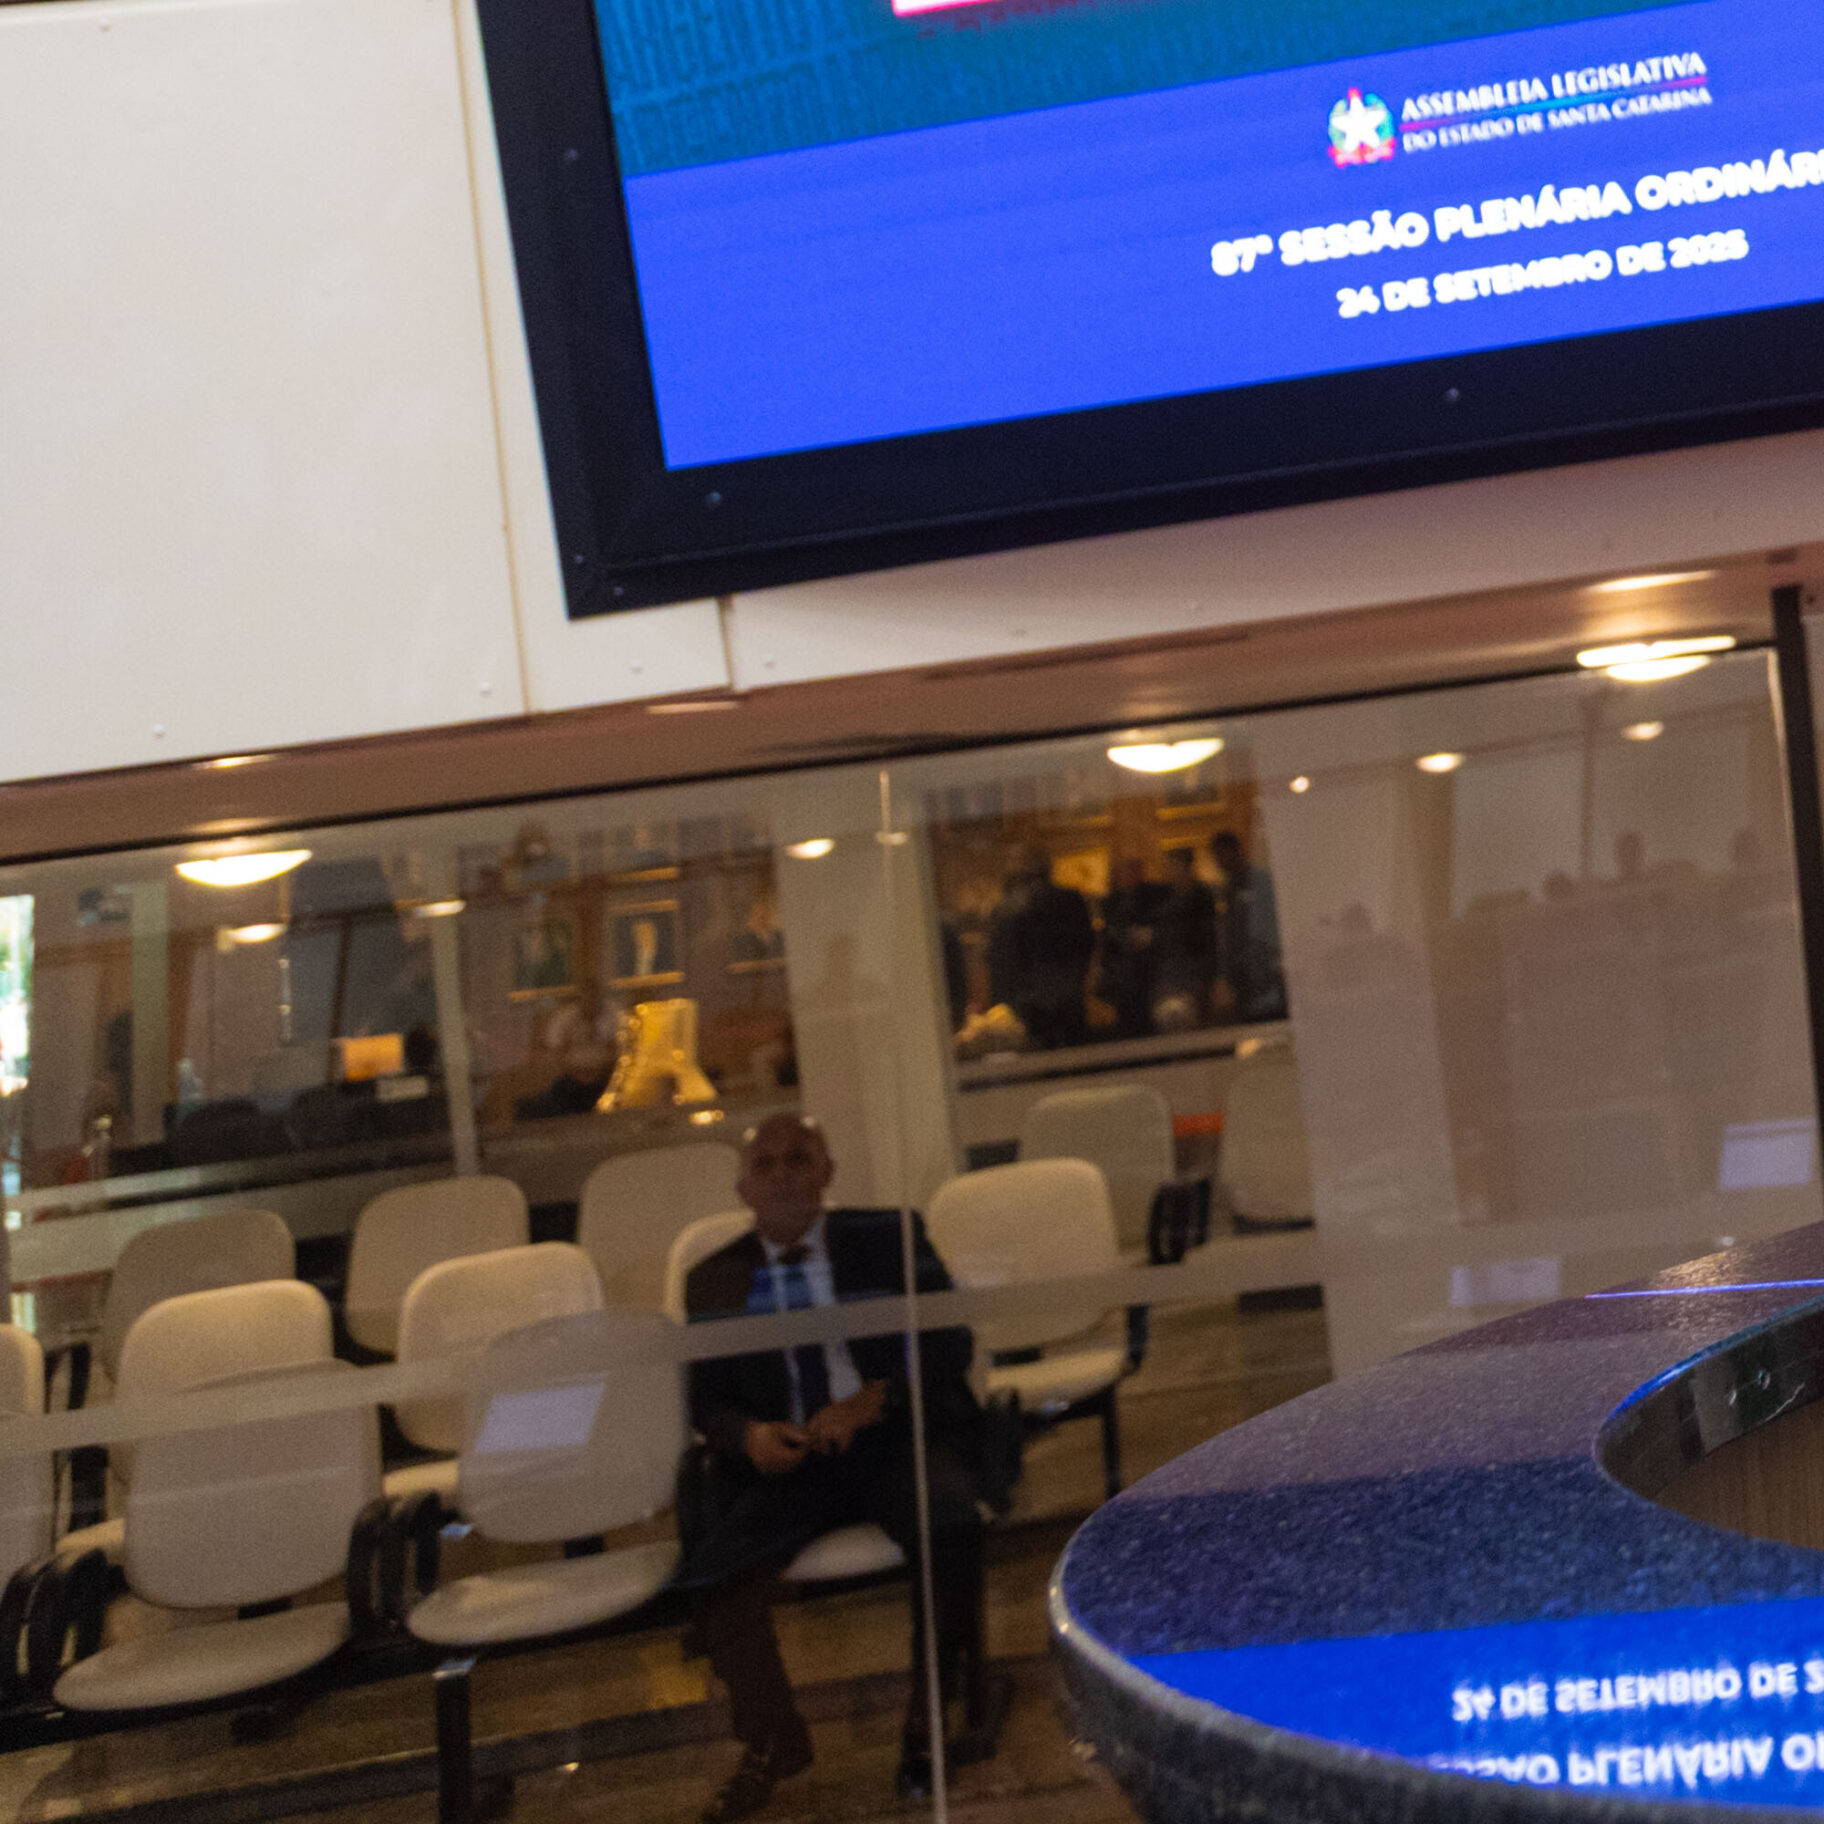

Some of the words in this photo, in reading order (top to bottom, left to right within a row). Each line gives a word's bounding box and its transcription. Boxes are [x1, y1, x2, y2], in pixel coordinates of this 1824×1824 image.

[1401, 76, 1549, 122] ASSEMBLEIA
[1550, 51, 1708, 100] LEGISLATIVA
[1402, 129, 1437, 154] DO
[1438, 117, 1515, 148] ESTADO
[1515, 112, 1544, 135] DE
[1547, 102, 1612, 128] SANTA
[1611, 87, 1713, 119] CATARINA
[1277, 209, 1430, 266] SESSÃO
[1433, 181, 1633, 243] PLENÁRIA
[1381, 276, 1432, 312] DE
[1432, 249, 1614, 304] SETEMBRO
[1615, 240, 1667, 277] DE
